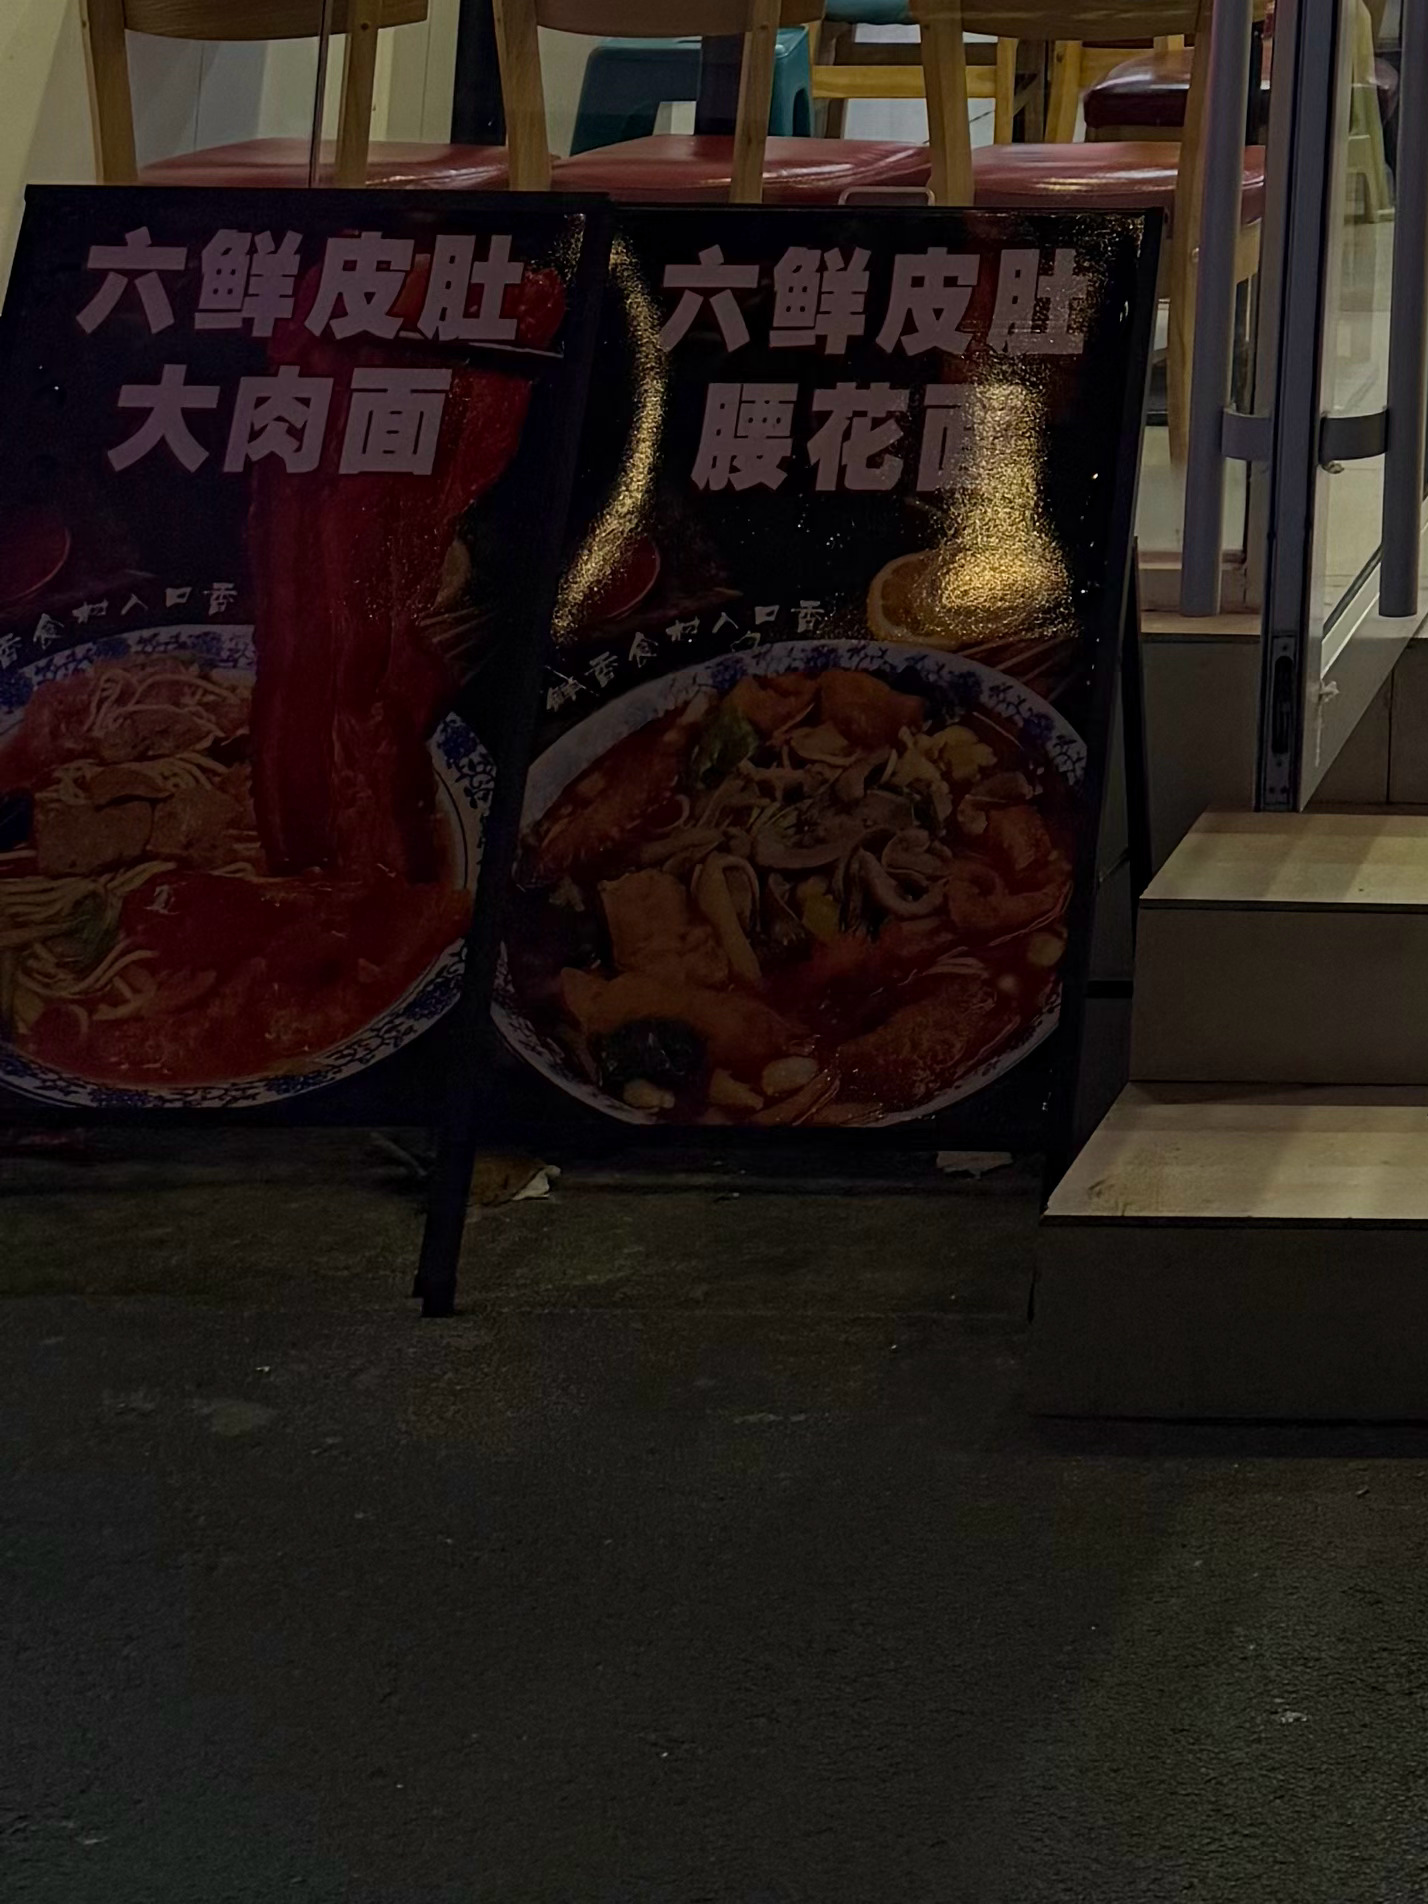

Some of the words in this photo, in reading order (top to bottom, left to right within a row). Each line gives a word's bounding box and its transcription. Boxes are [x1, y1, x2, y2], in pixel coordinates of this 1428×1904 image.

[75, 226, 523, 342] 六鲜皮肚
[662, 243, 1092, 358] 六鲜皮肚
[107, 365, 459, 478] 大肉面
